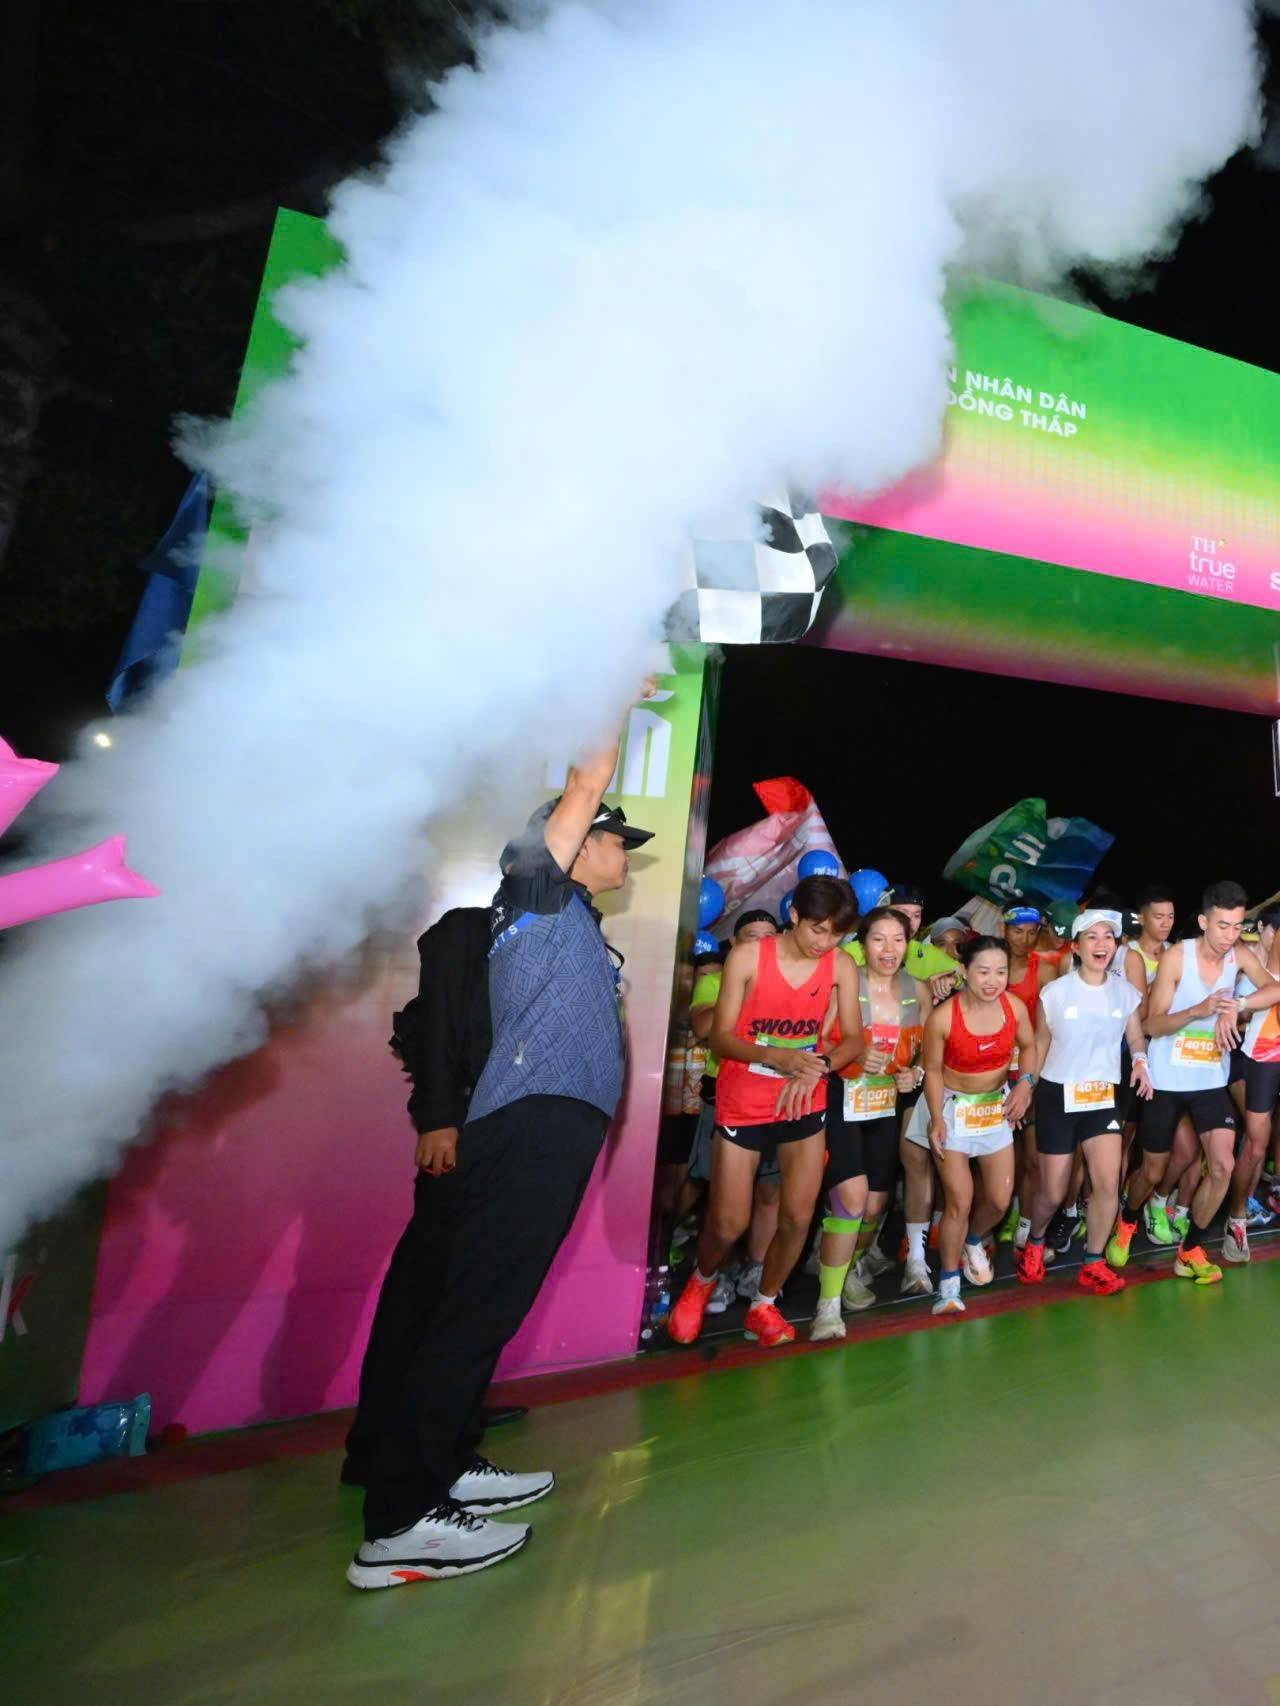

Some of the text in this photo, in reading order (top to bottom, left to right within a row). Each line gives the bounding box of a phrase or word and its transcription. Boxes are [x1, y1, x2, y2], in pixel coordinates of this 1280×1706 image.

[965, 370, 1032, 404] NHÂN
[1039, 392, 1086, 419] DÂN
[1020, 408, 1077, 438] THÁP
[1190, 536, 1217, 554] TH
[1188, 551, 1236, 579] true
[1188, 575, 1233, 592] WATER
[748, 1019, 820, 1036] SWOOS
